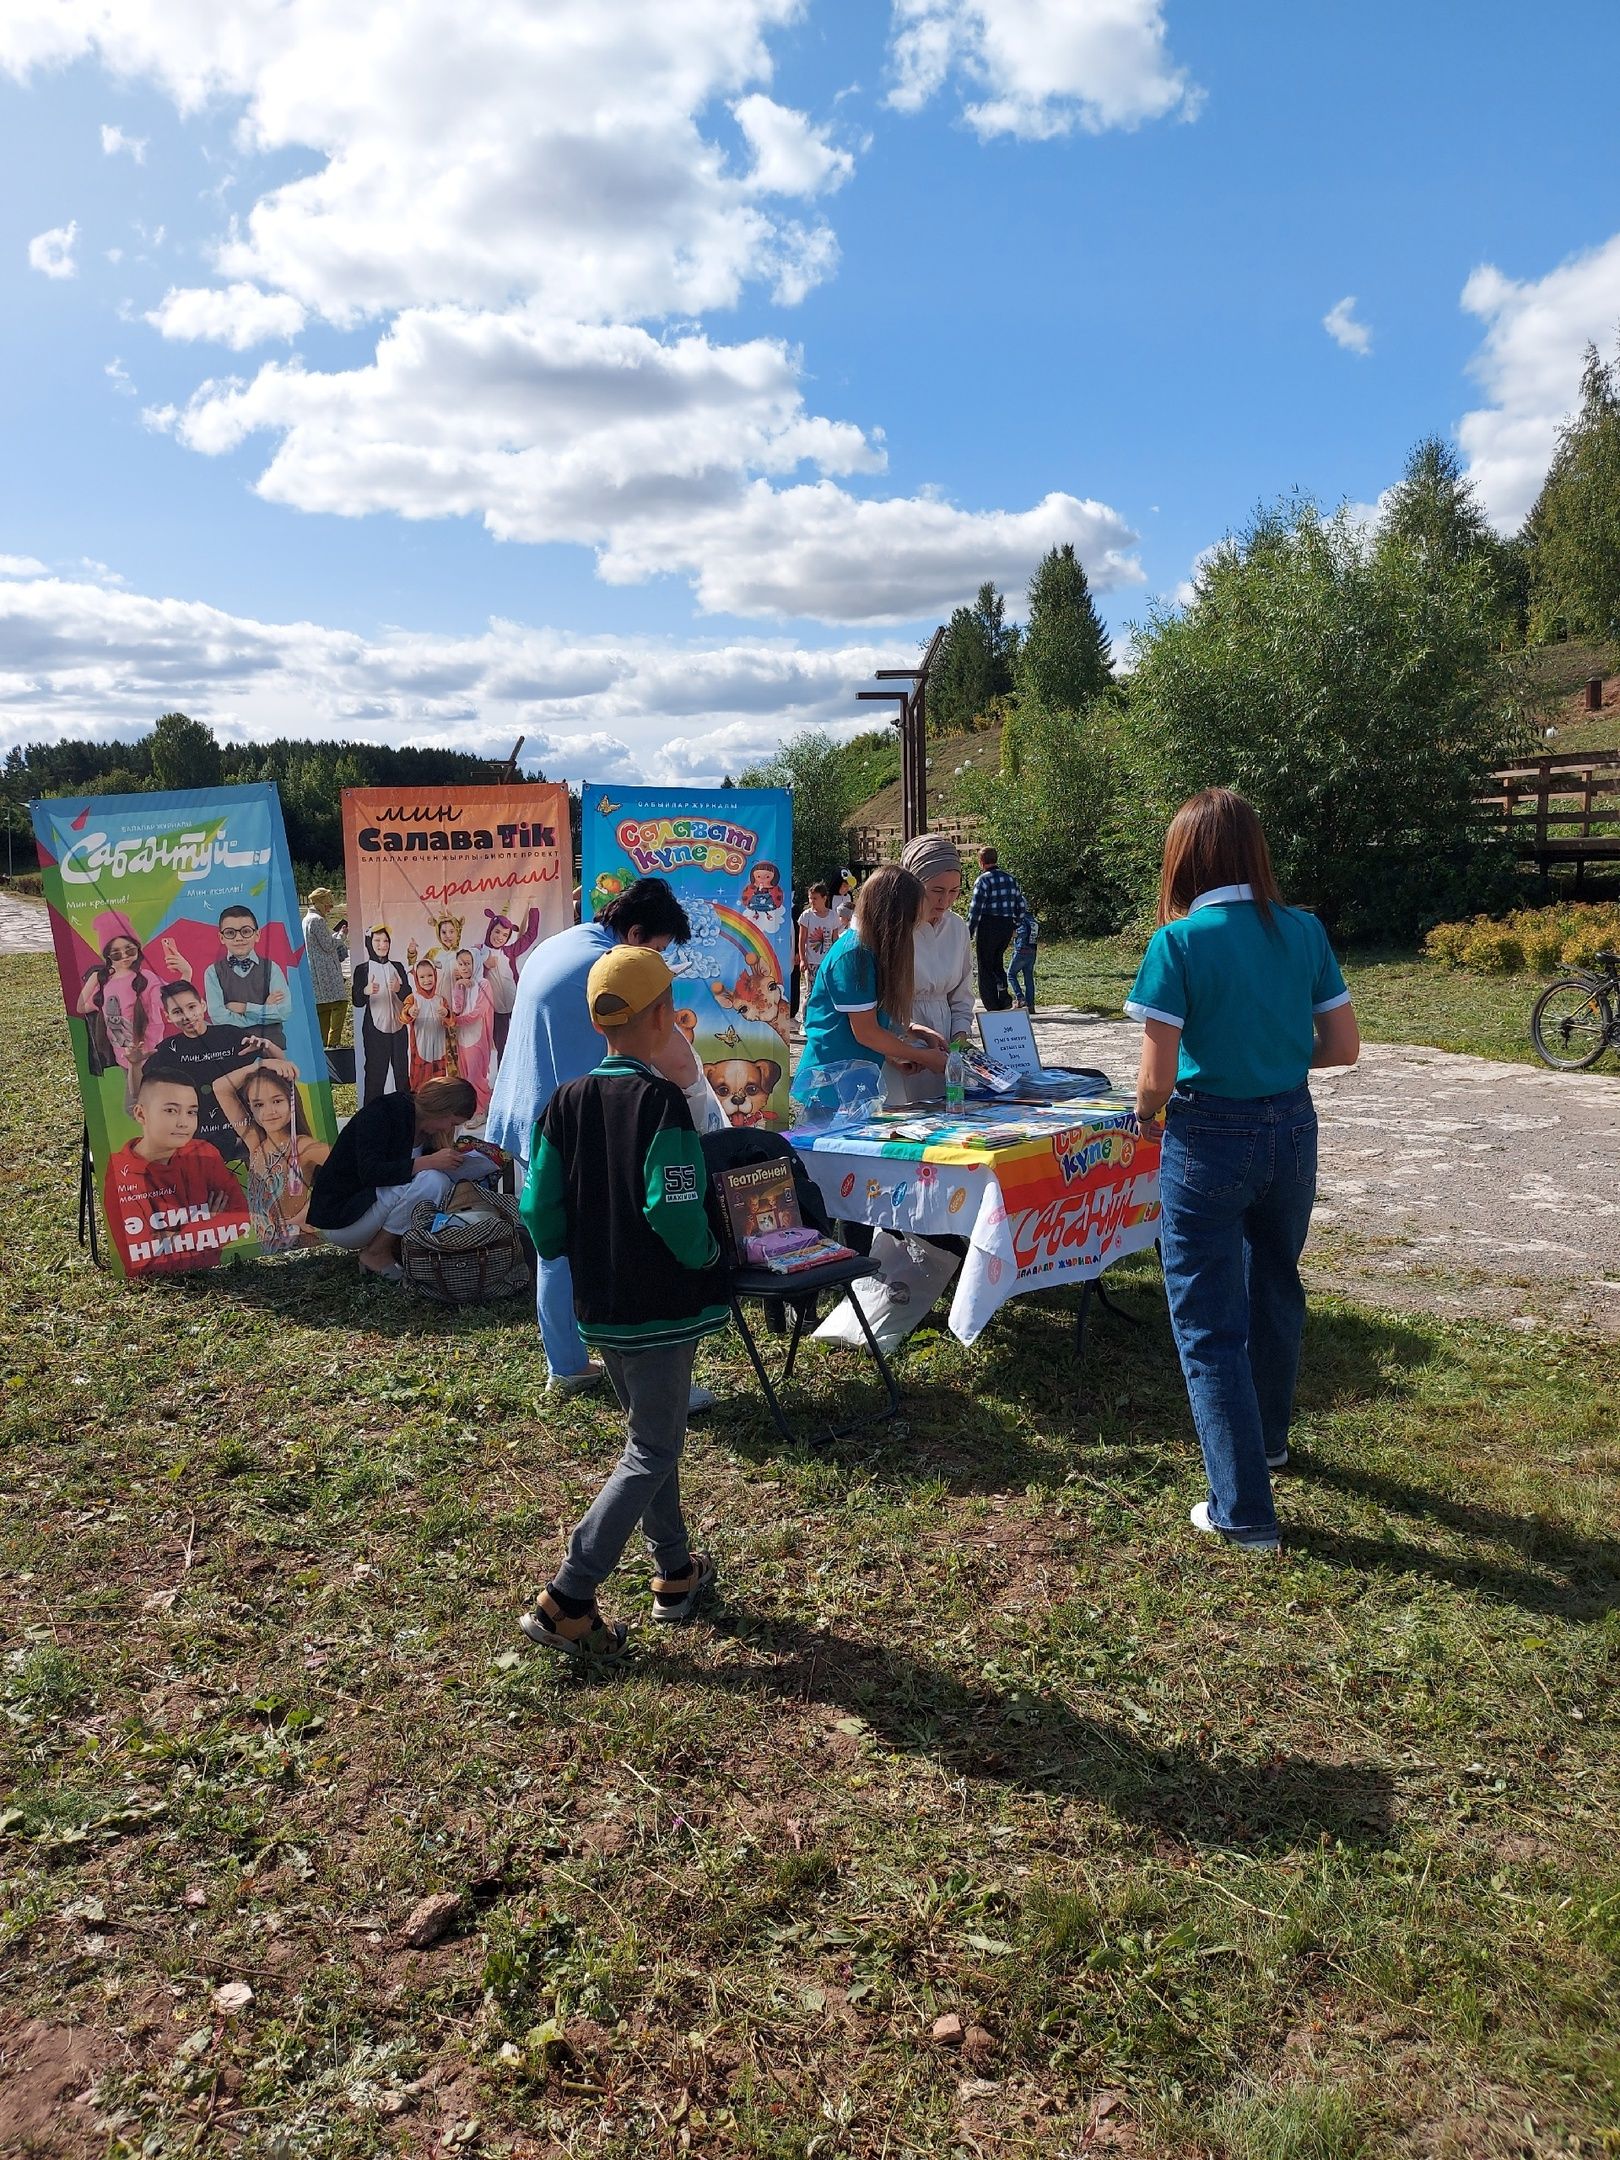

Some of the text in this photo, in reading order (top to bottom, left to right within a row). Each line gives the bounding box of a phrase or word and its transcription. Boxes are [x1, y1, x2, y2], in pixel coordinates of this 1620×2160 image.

[618, 819, 754, 851] Салават
[60, 830, 271, 884] Сабантуй
[521, 850, 559, 859] ПРОЕКТ
[66, 901, 87, 909] Мин
[180, 1054, 200, 1063] Мин
[200, 1125, 220, 1133] Мин
[664, 1164, 696, 1192] 55
[117, 1183, 138, 1194] Мин
[128, 1222, 251, 1262] НИНДИ?
